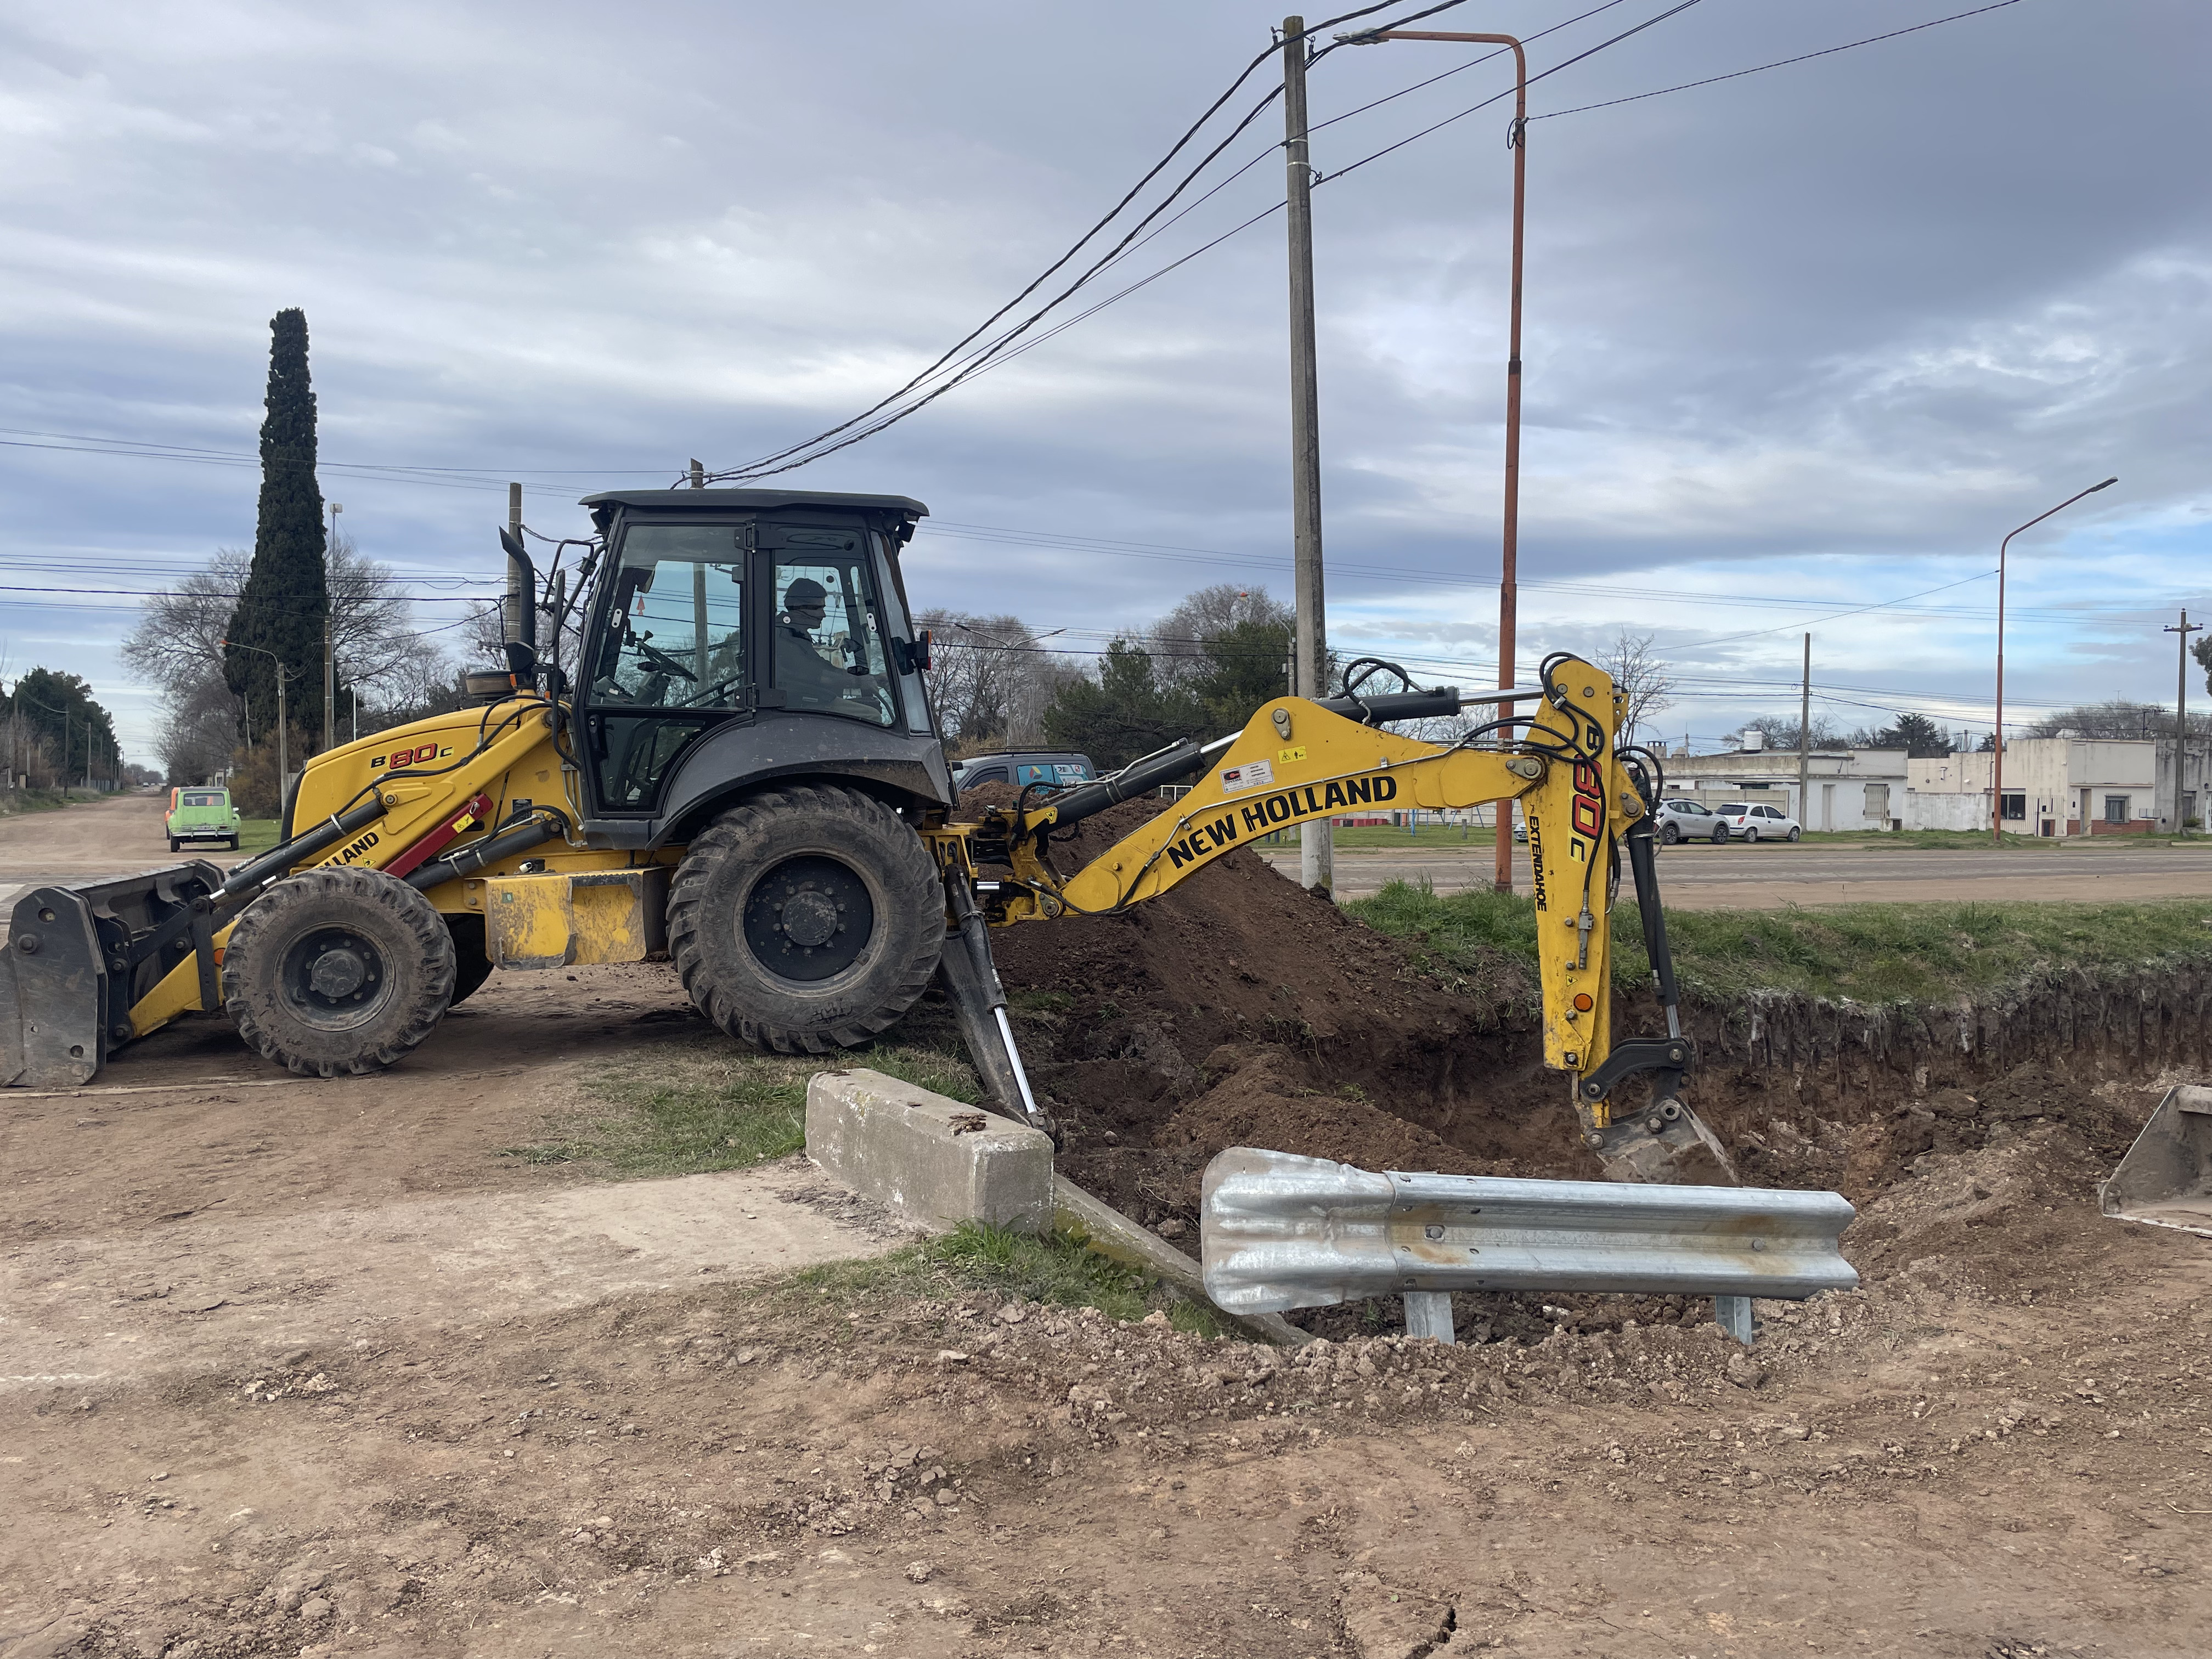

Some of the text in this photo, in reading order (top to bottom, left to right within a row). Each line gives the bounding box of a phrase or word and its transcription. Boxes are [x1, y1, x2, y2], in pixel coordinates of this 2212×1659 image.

[321, 832, 379, 866] LAND
[1166, 776, 1397, 869] NEW HOLLAND
[1529, 815, 1547, 912] EXTENDAHOE
